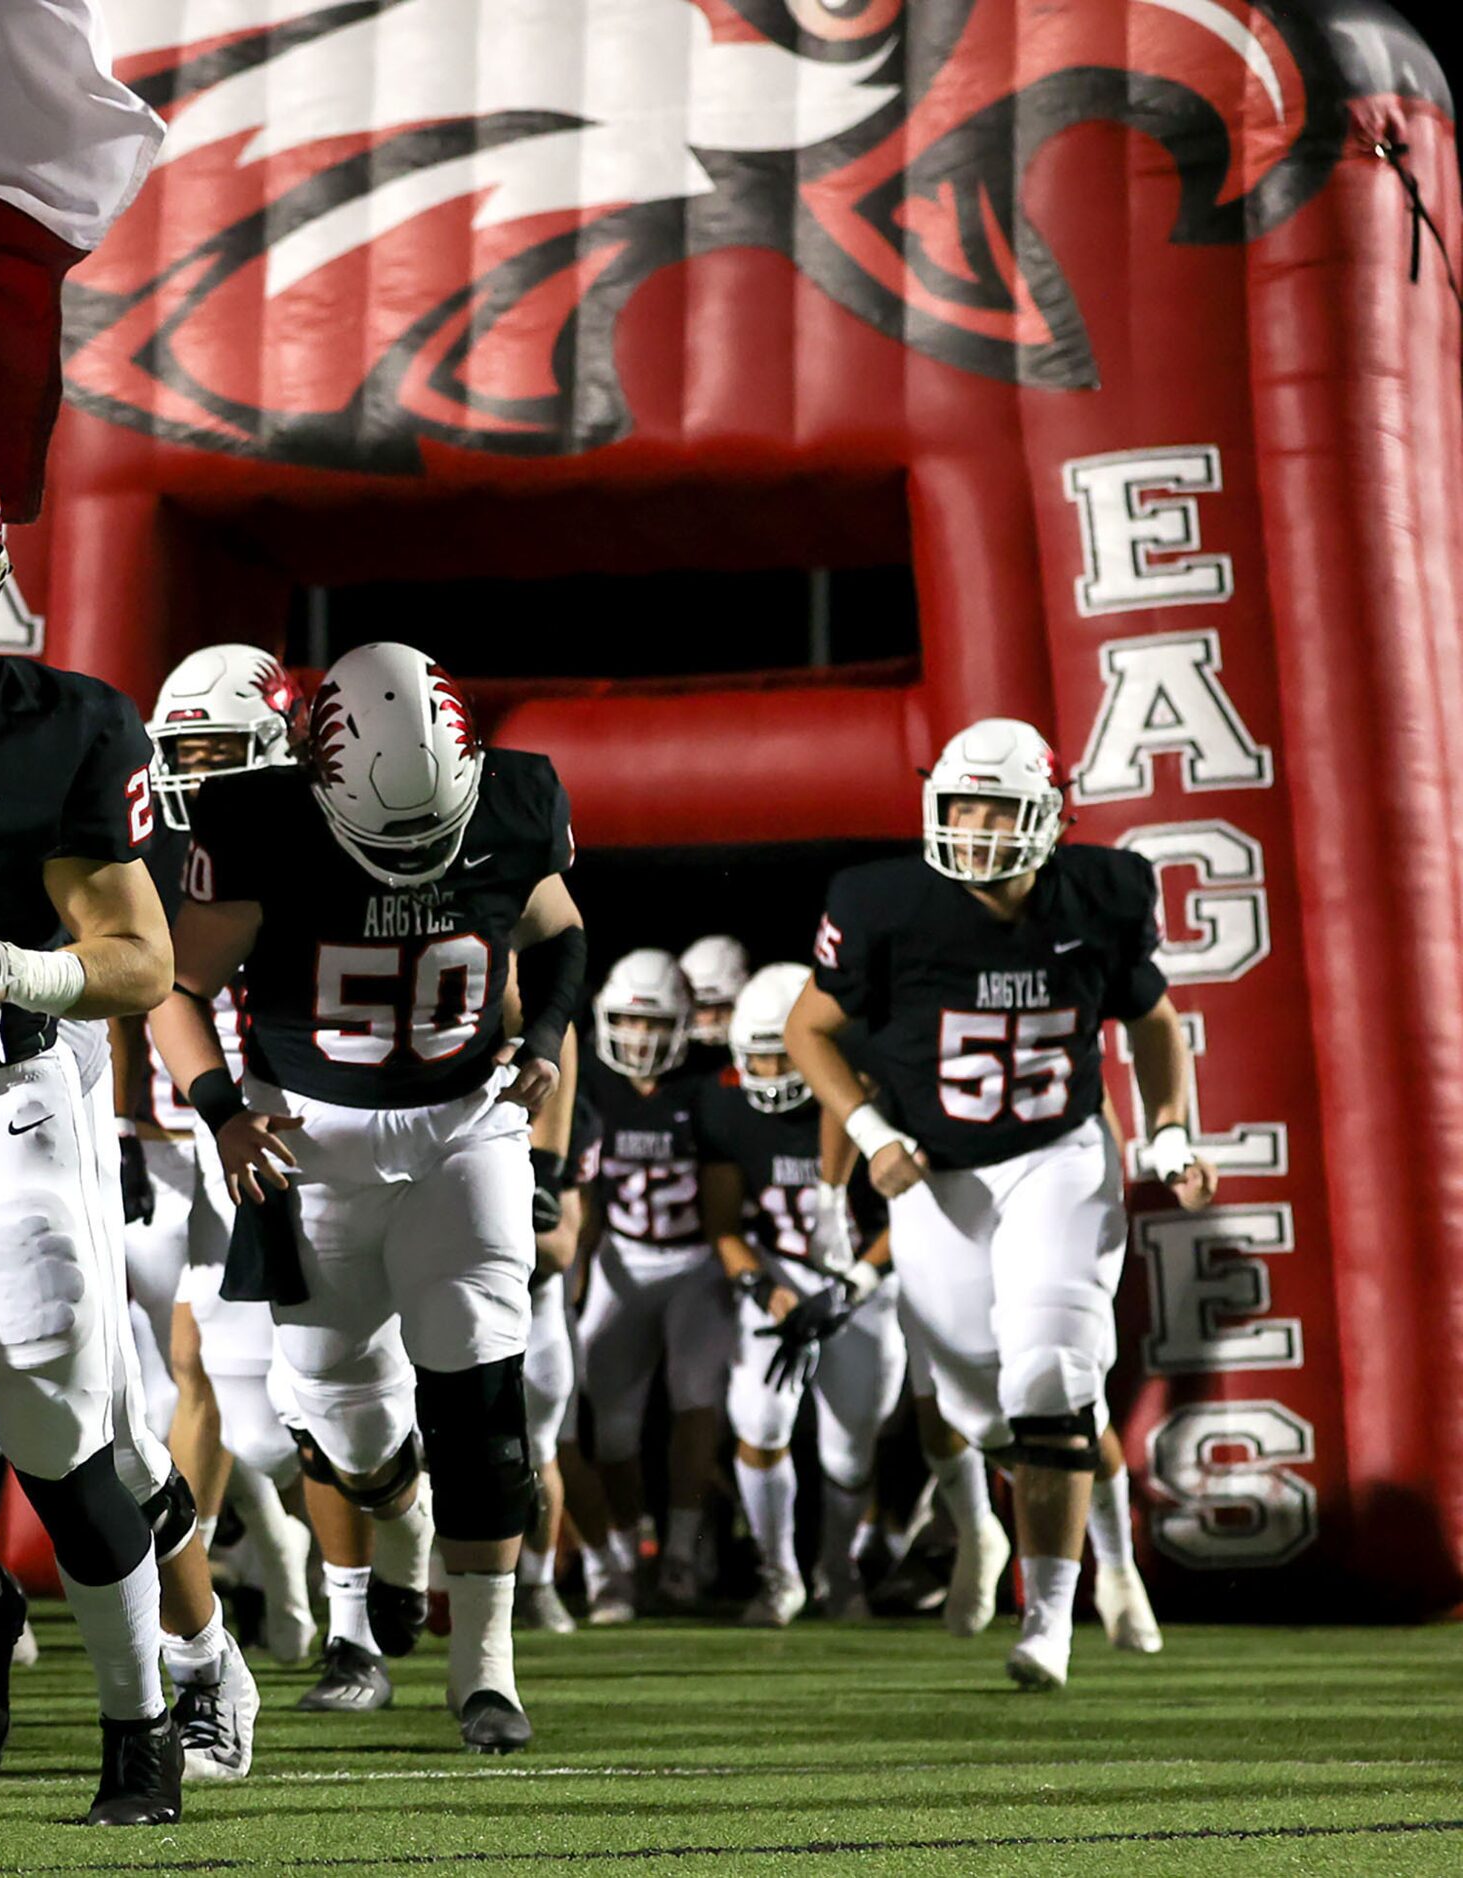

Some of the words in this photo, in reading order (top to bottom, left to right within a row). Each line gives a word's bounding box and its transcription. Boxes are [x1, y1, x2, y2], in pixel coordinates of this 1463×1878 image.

[124, 763, 156, 848] 2
[179, 838, 217, 904] 0
[312, 932, 493, 1068] 50
[976, 969, 1051, 1009] ARGYLE
[938, 1007, 1079, 1124] 55
[600, 1156, 702, 1240] 32
